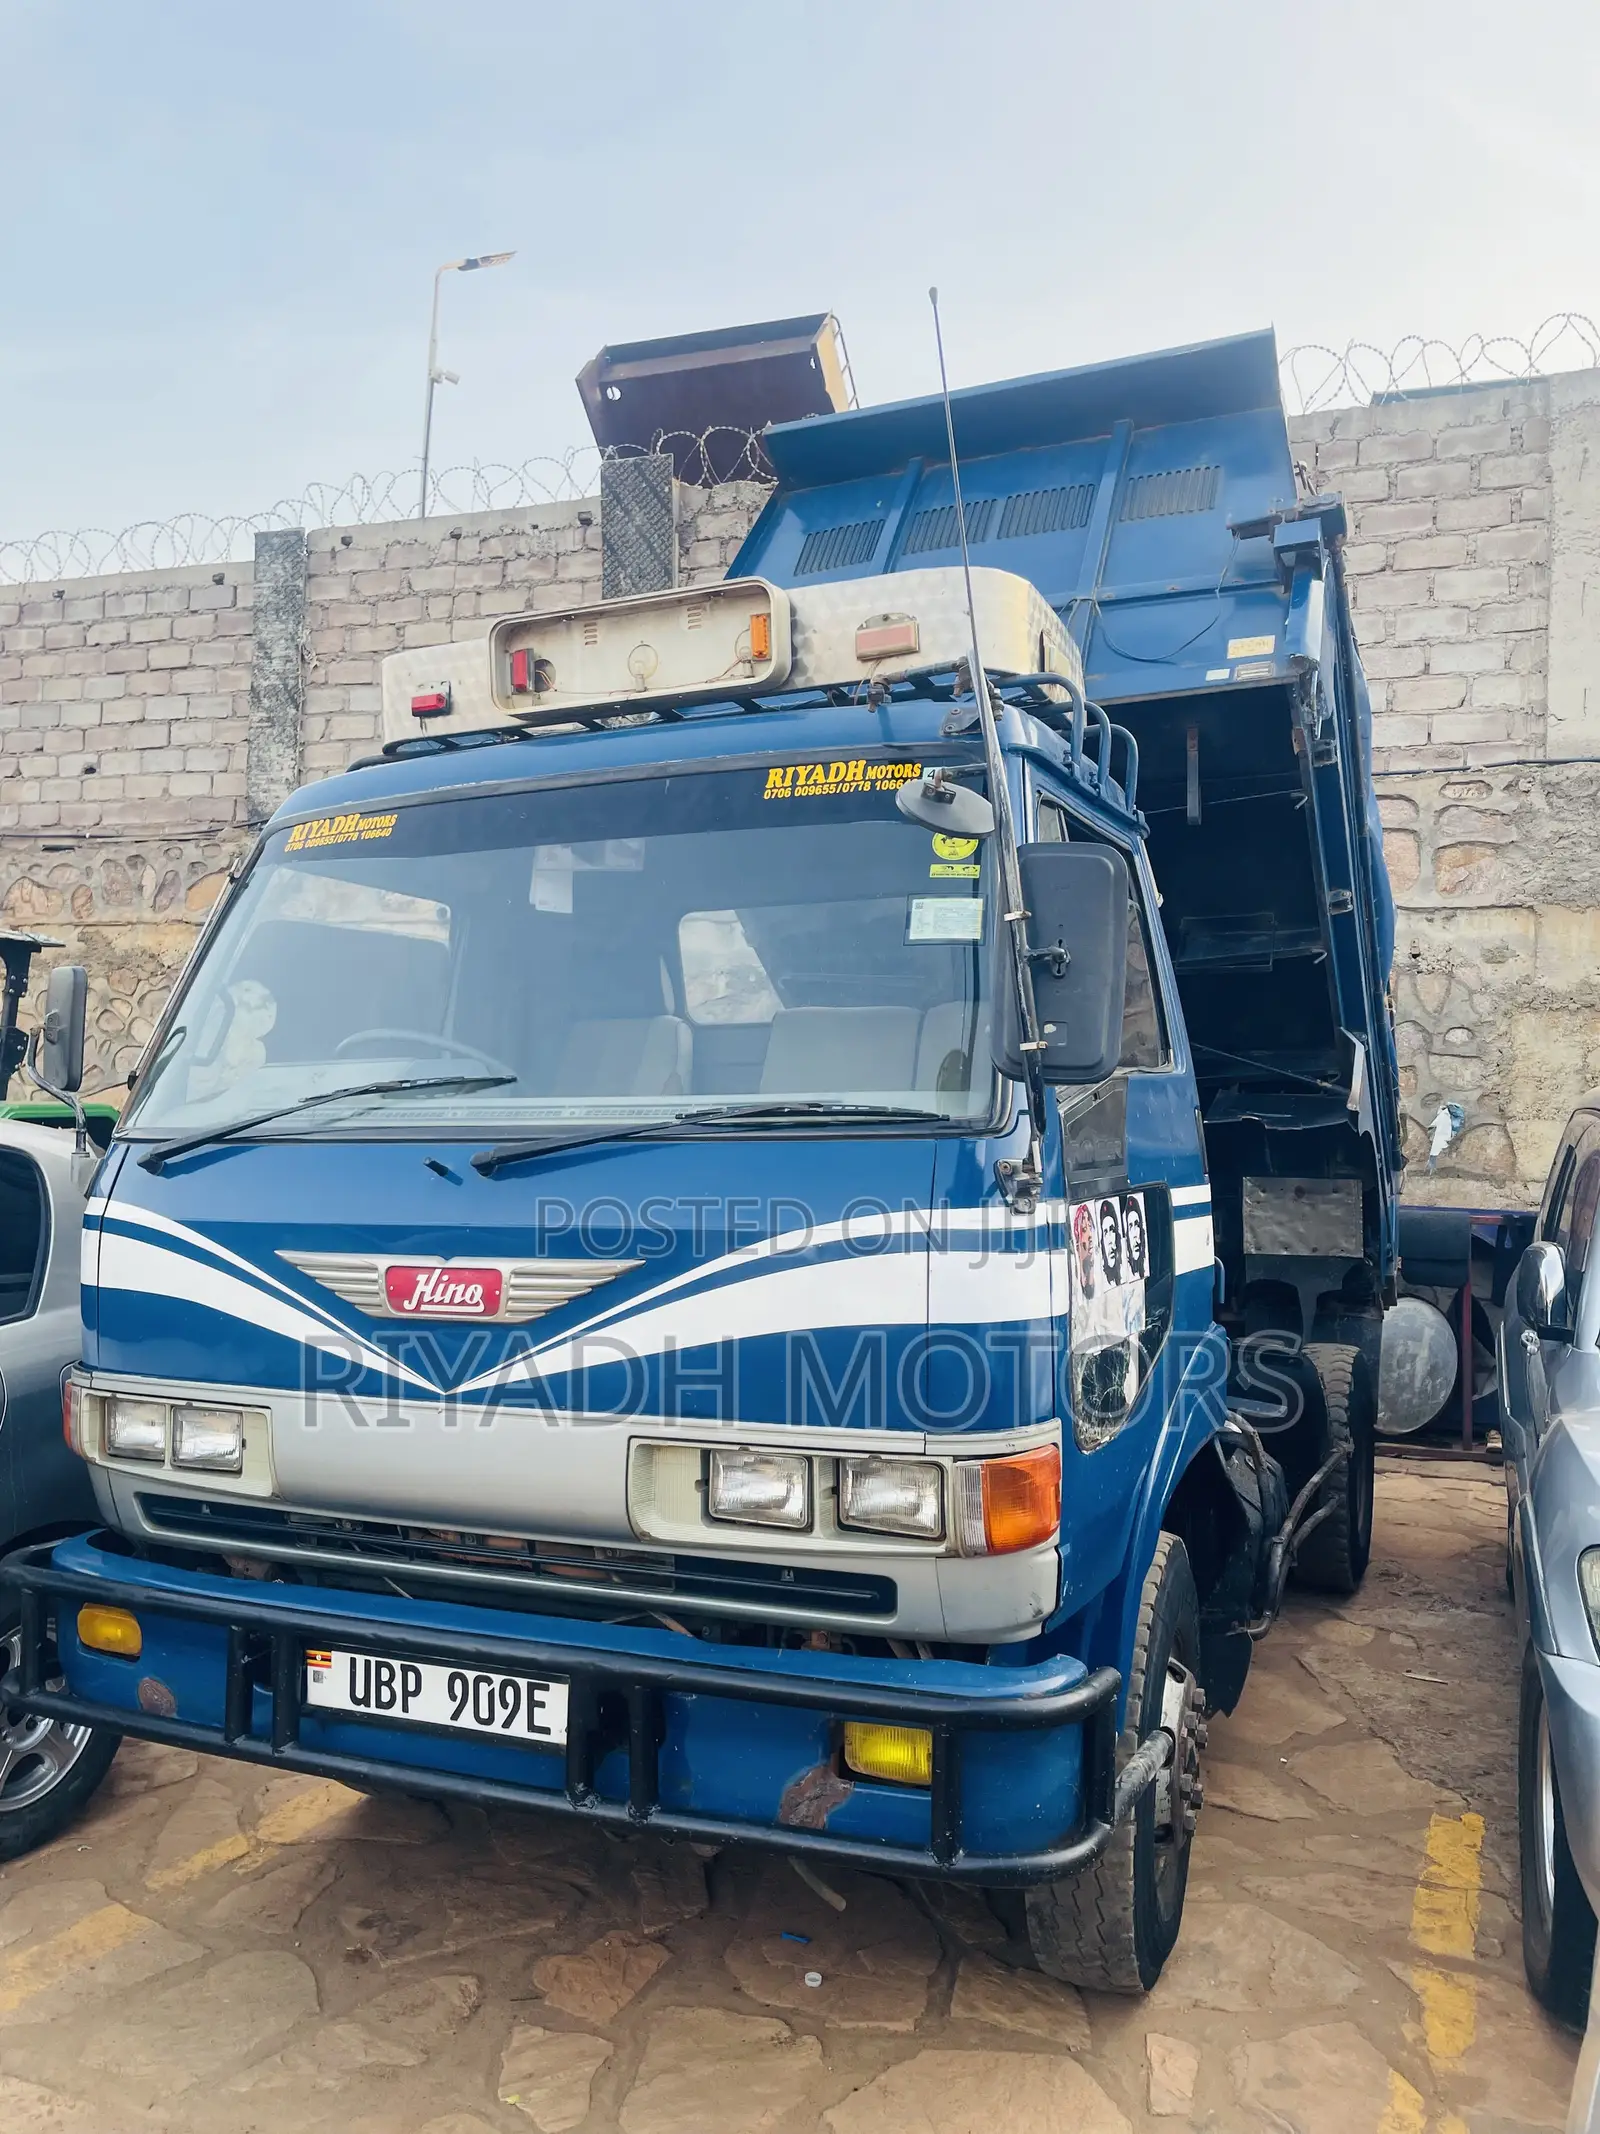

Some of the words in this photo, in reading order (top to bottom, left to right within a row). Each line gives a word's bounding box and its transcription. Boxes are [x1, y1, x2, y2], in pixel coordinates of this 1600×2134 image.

[763, 787, 792, 800] 0706
[794, 780, 871, 797] 009655/0778
[875, 778, 918, 792] 1066
[765, 759, 867, 789] RIYADH
[866, 763, 921, 780] MOTORS
[288, 813, 360, 842] RIYADH
[356, 814, 398, 832] MOTORS
[403, 1268, 486, 1313] Hino
[349, 1656, 422, 1714] UBP
[447, 1671, 552, 1736] 909E
